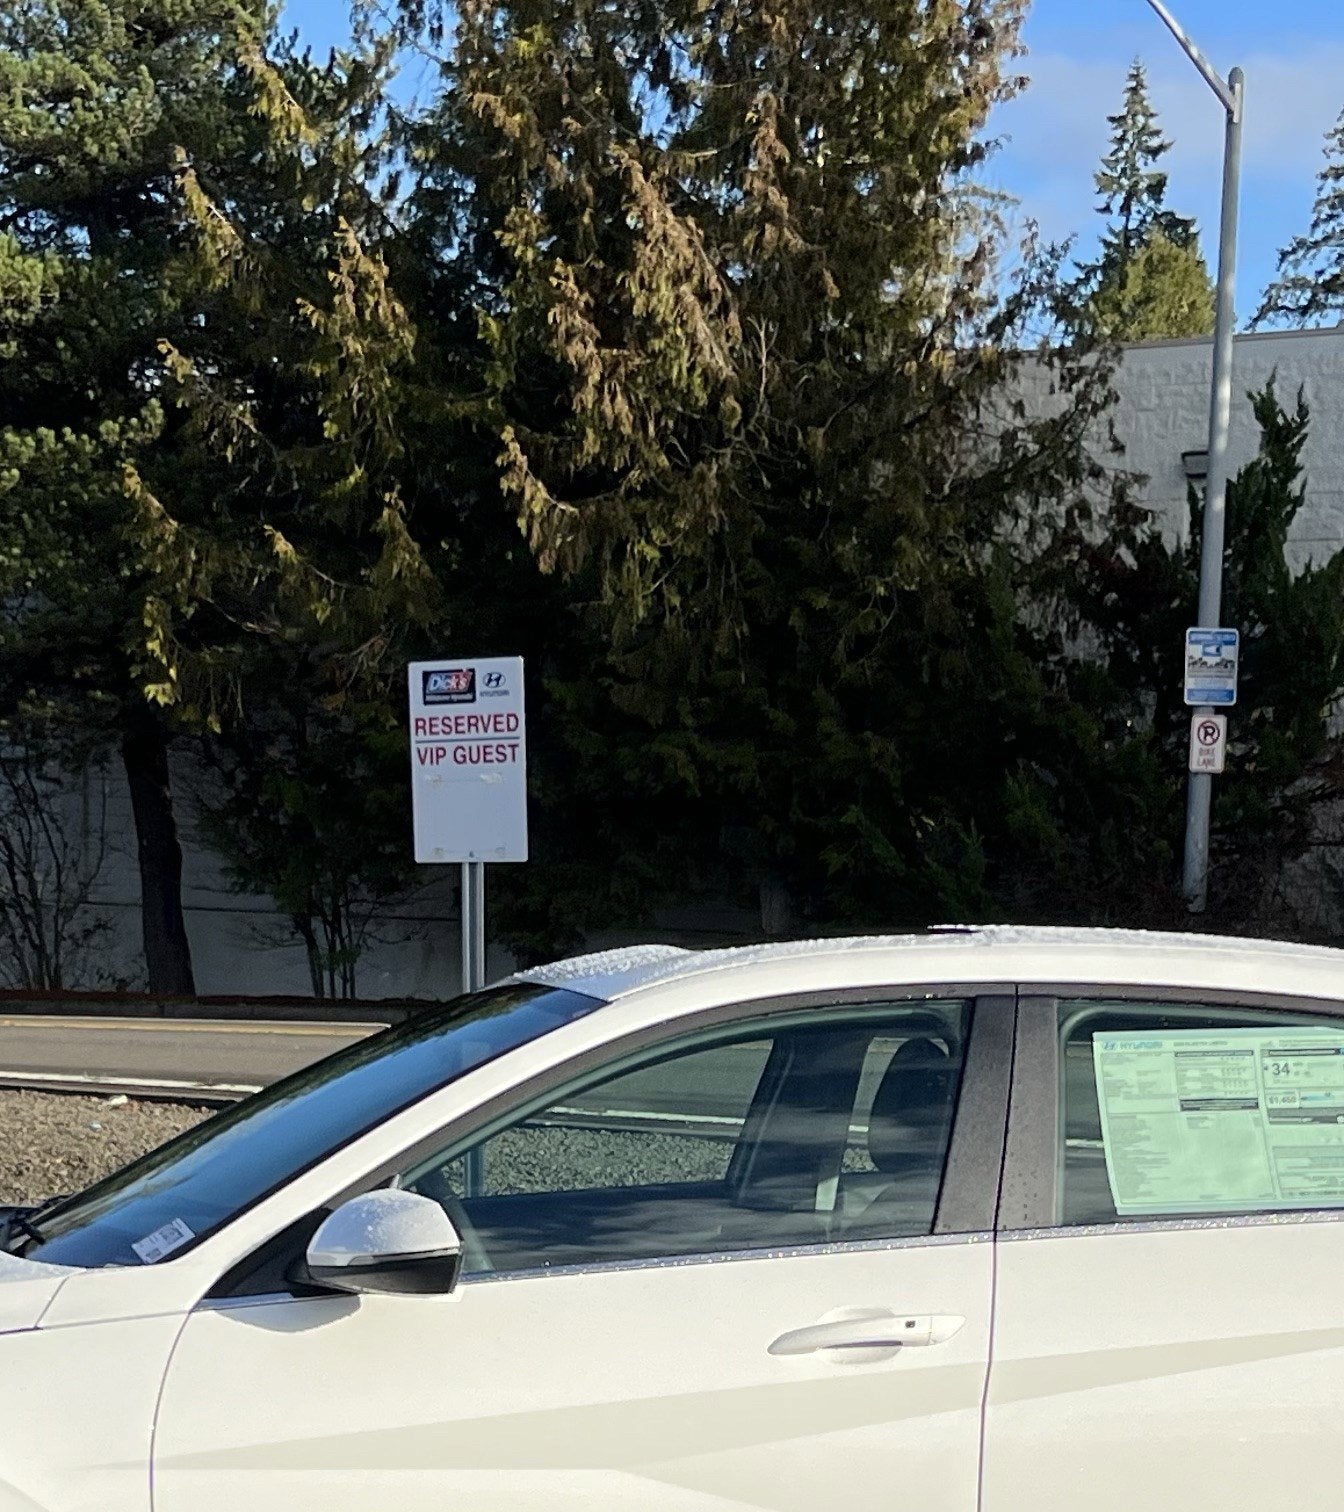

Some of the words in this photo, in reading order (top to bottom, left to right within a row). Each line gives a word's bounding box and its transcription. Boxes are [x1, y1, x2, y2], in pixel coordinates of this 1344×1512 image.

[414, 713, 520, 737] RESERVED
[416, 746, 447, 766] VIP
[453, 743, 520, 765] GUEST
[1271, 1062, 1291, 1077] 34
